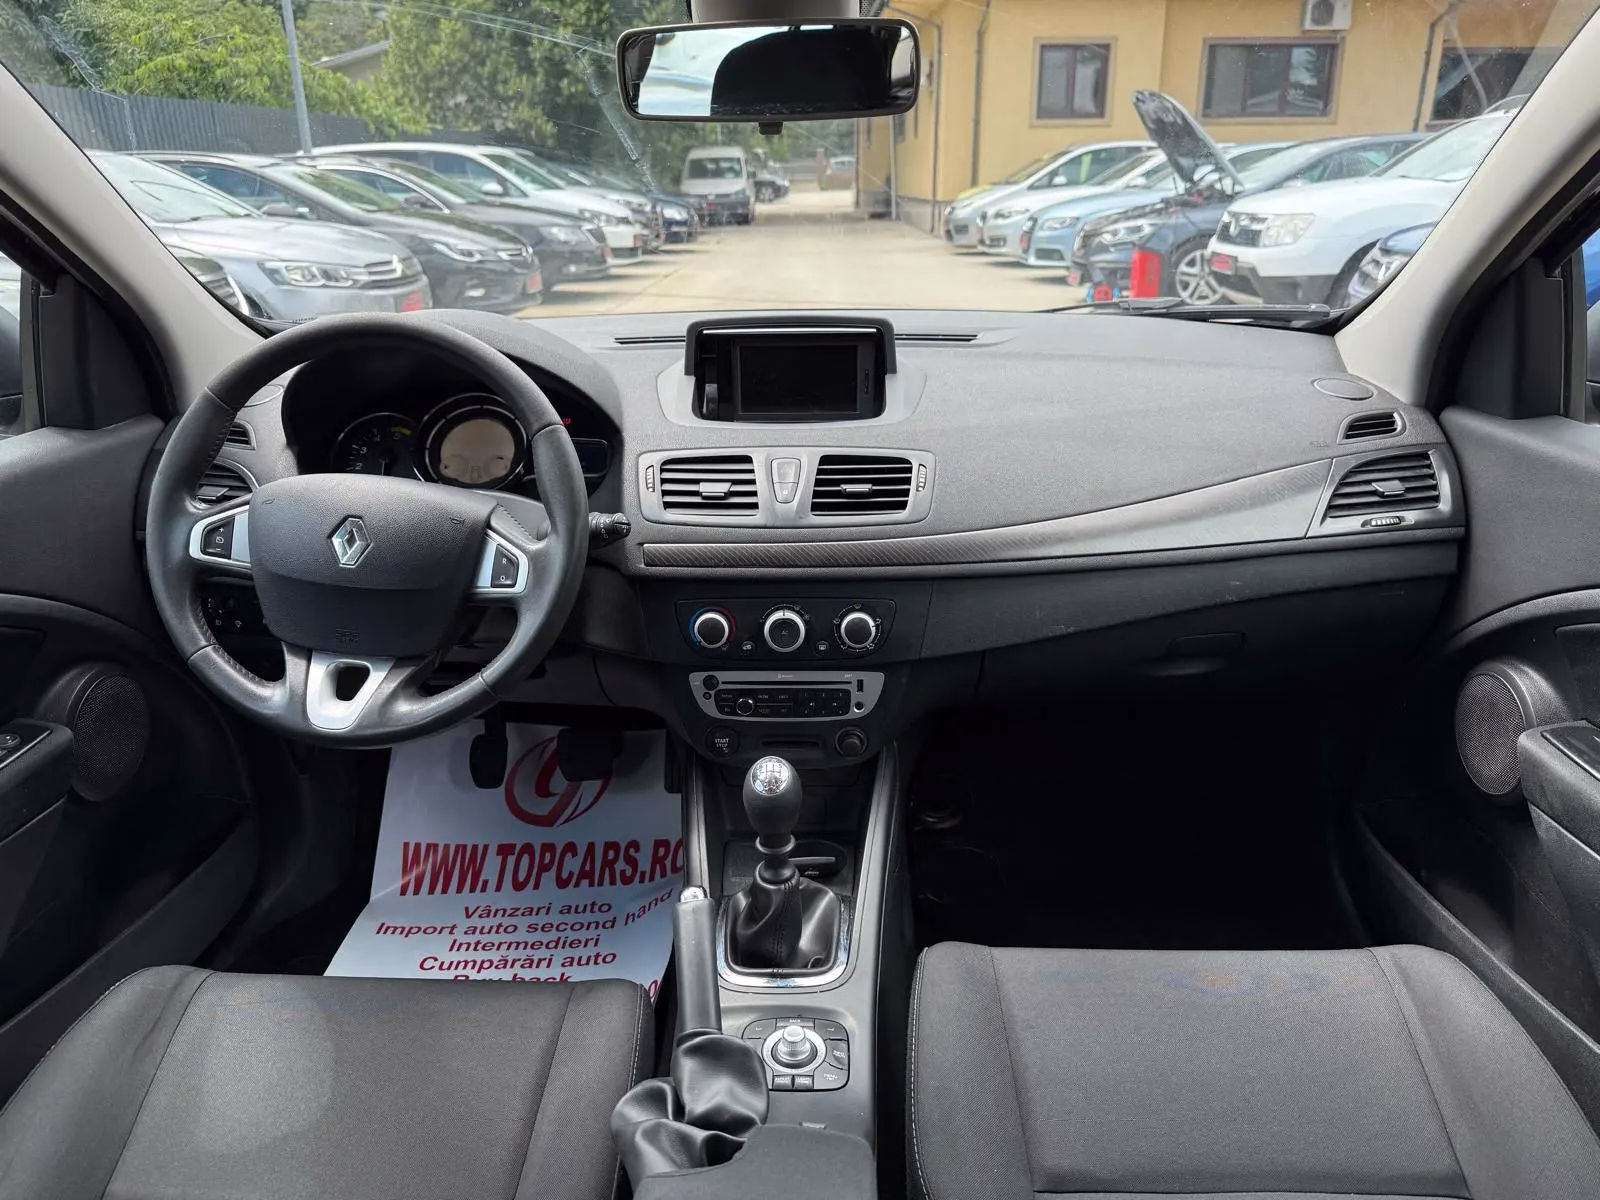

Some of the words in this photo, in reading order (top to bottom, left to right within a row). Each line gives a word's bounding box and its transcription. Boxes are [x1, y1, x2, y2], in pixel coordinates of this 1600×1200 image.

[375, 922, 458, 938] Import
[463, 921, 519, 935] auto
[525, 916, 618, 933] second
[623, 888, 674, 927] hand
[463, 905, 552, 920] Vânzari
[558, 900, 612, 915] auto
[448, 934, 602, 952] Intermedieri
[419, 954, 555, 974] Cumpărări
[560, 951, 618, 968] auto
